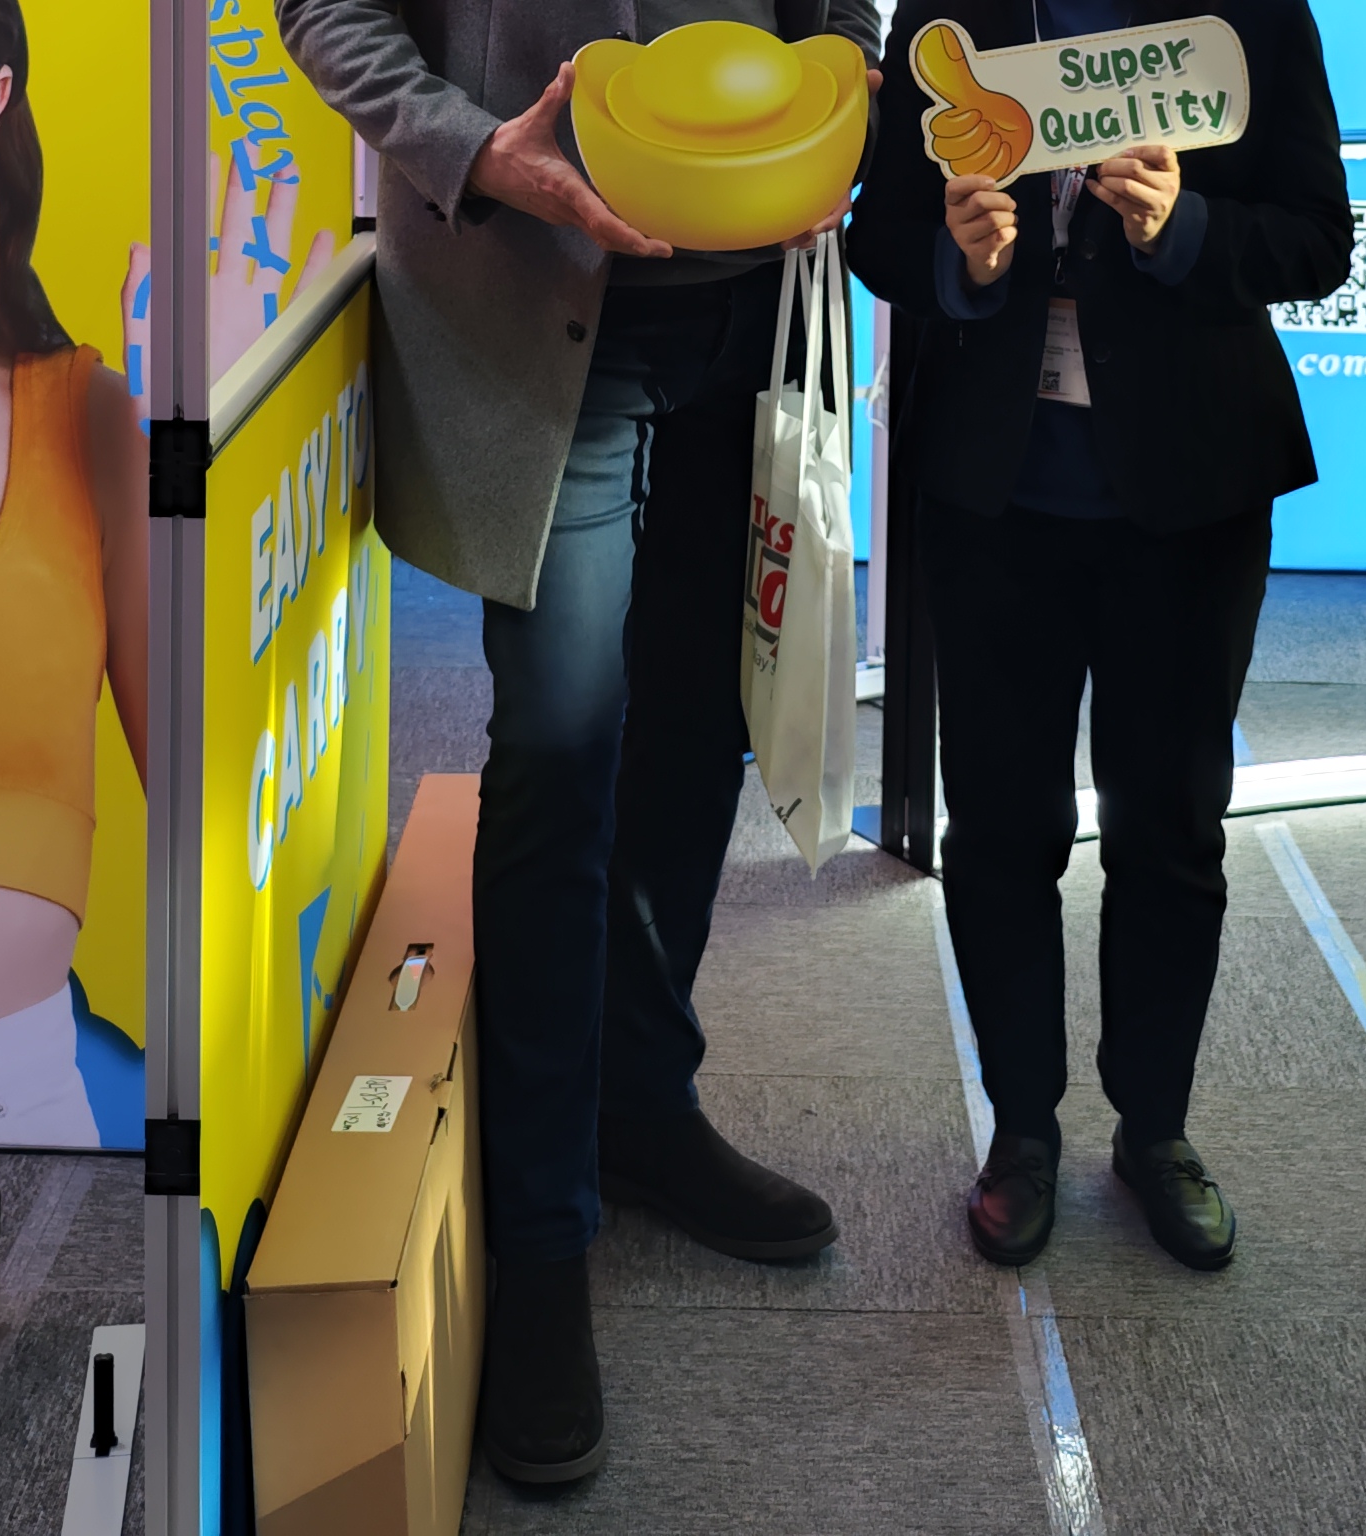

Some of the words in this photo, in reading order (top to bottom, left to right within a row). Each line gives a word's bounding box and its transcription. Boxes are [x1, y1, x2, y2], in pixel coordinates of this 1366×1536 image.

[1038, 89, 1228, 149] Quality
[1058, 35, 1193, 90] Super
[249, 410, 332, 666] EASY
[338, 359, 373, 516] TO
[247, 543, 371, 892] CARRY
